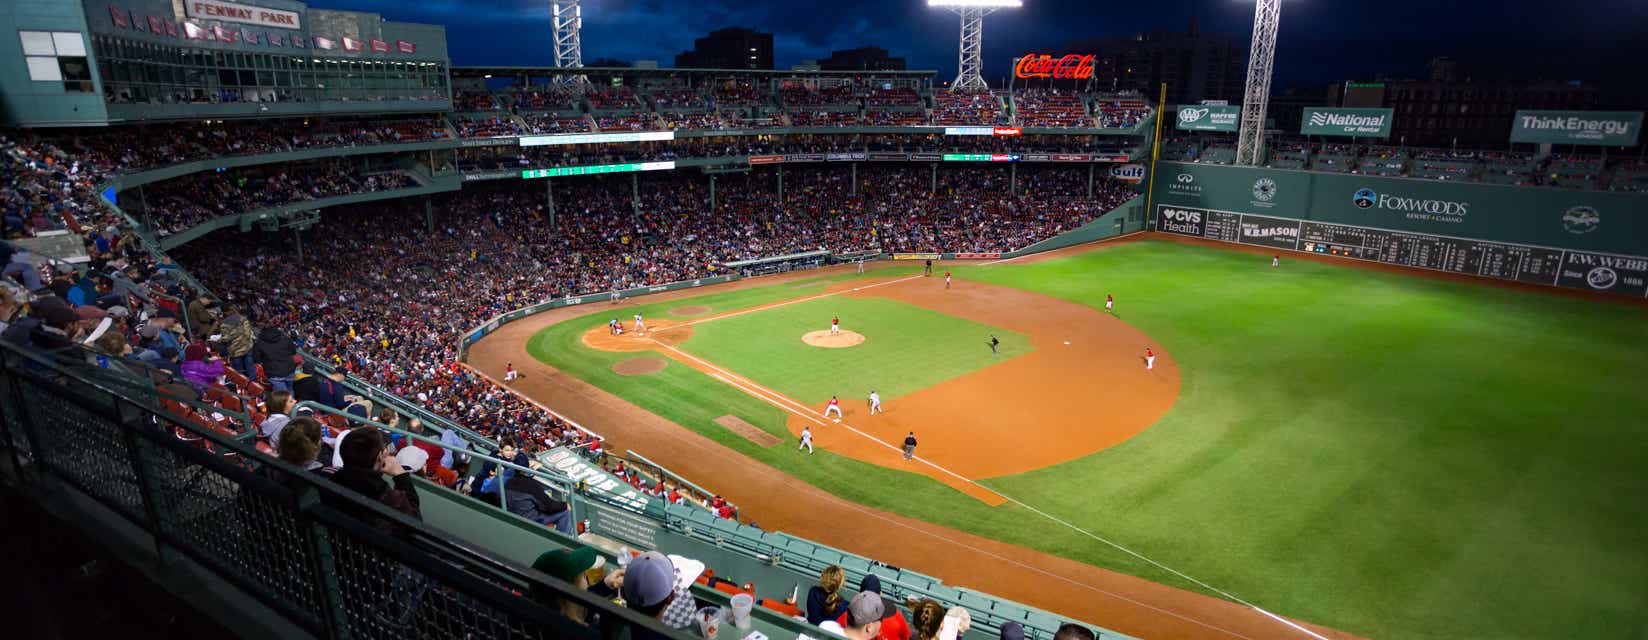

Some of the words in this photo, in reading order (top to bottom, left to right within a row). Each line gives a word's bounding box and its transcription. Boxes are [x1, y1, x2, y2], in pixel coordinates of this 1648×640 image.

[194, 2, 252, 20] FENWAY
[260, 11, 294, 25] PARK
[1016, 53, 1093, 79] Coca-Cola
[1325, 113, 1385, 126] National
[1522, 115, 1629, 134] ThinkEnergy
[1111, 166, 1143, 177] Gulf
[1378, 193, 1471, 216] FOXWOODS
[1175, 210, 1201, 223] CVS
[1163, 219, 1200, 235] Health
[1568, 253, 1596, 266] F.W.
[1599, 256, 1648, 271] WEBB
[546, 451, 619, 493] BOSTON
